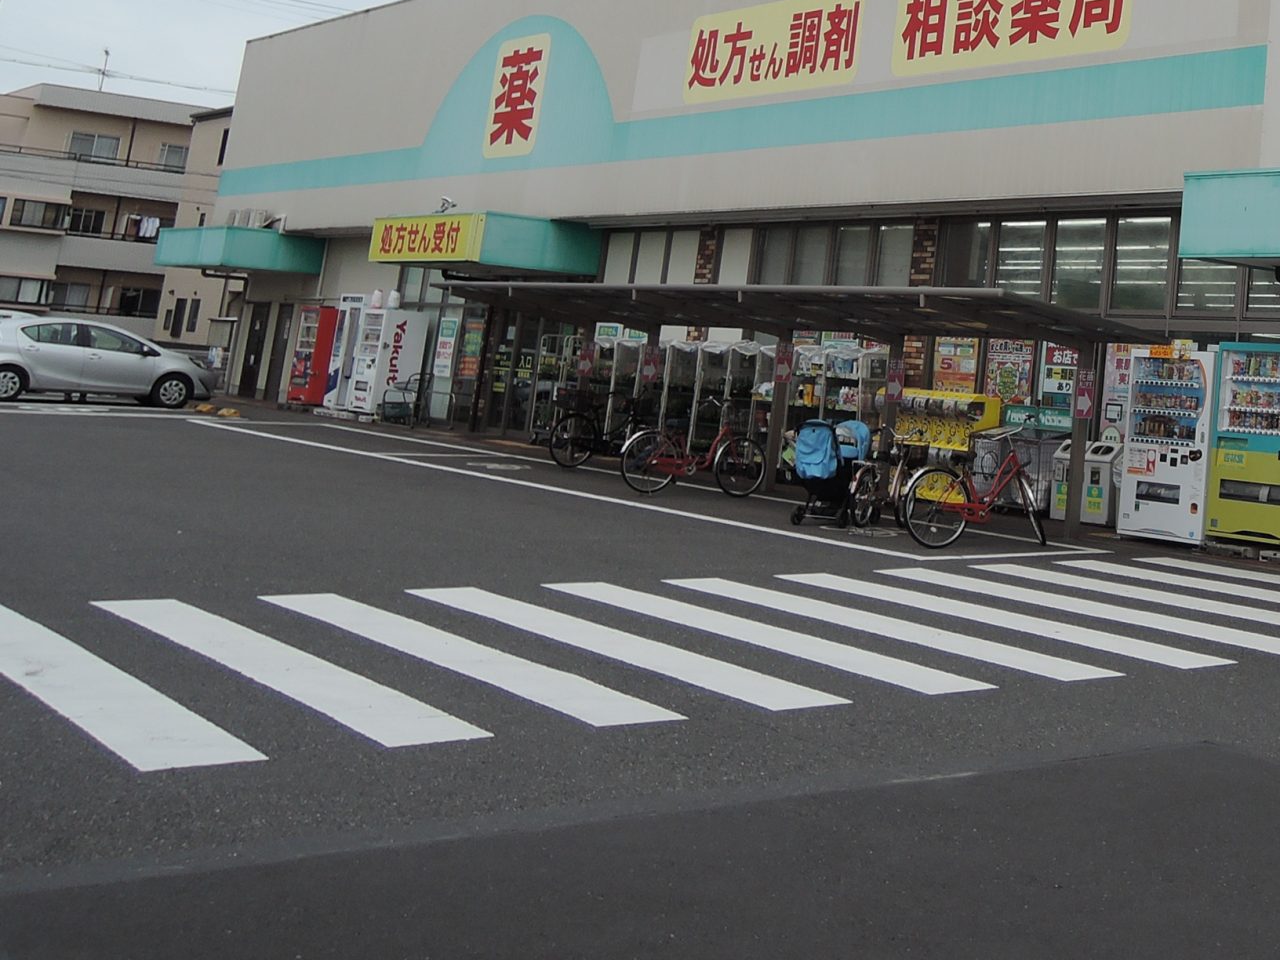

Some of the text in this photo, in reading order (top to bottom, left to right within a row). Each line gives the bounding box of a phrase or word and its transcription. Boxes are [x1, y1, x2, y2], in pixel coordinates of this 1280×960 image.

[688, 0, 862, 90] 処方せん調剤
[489, 47, 544, 146] 薬
[380, 221, 461, 254] 処方せん受付
[386, 320, 408, 386] Yakult
